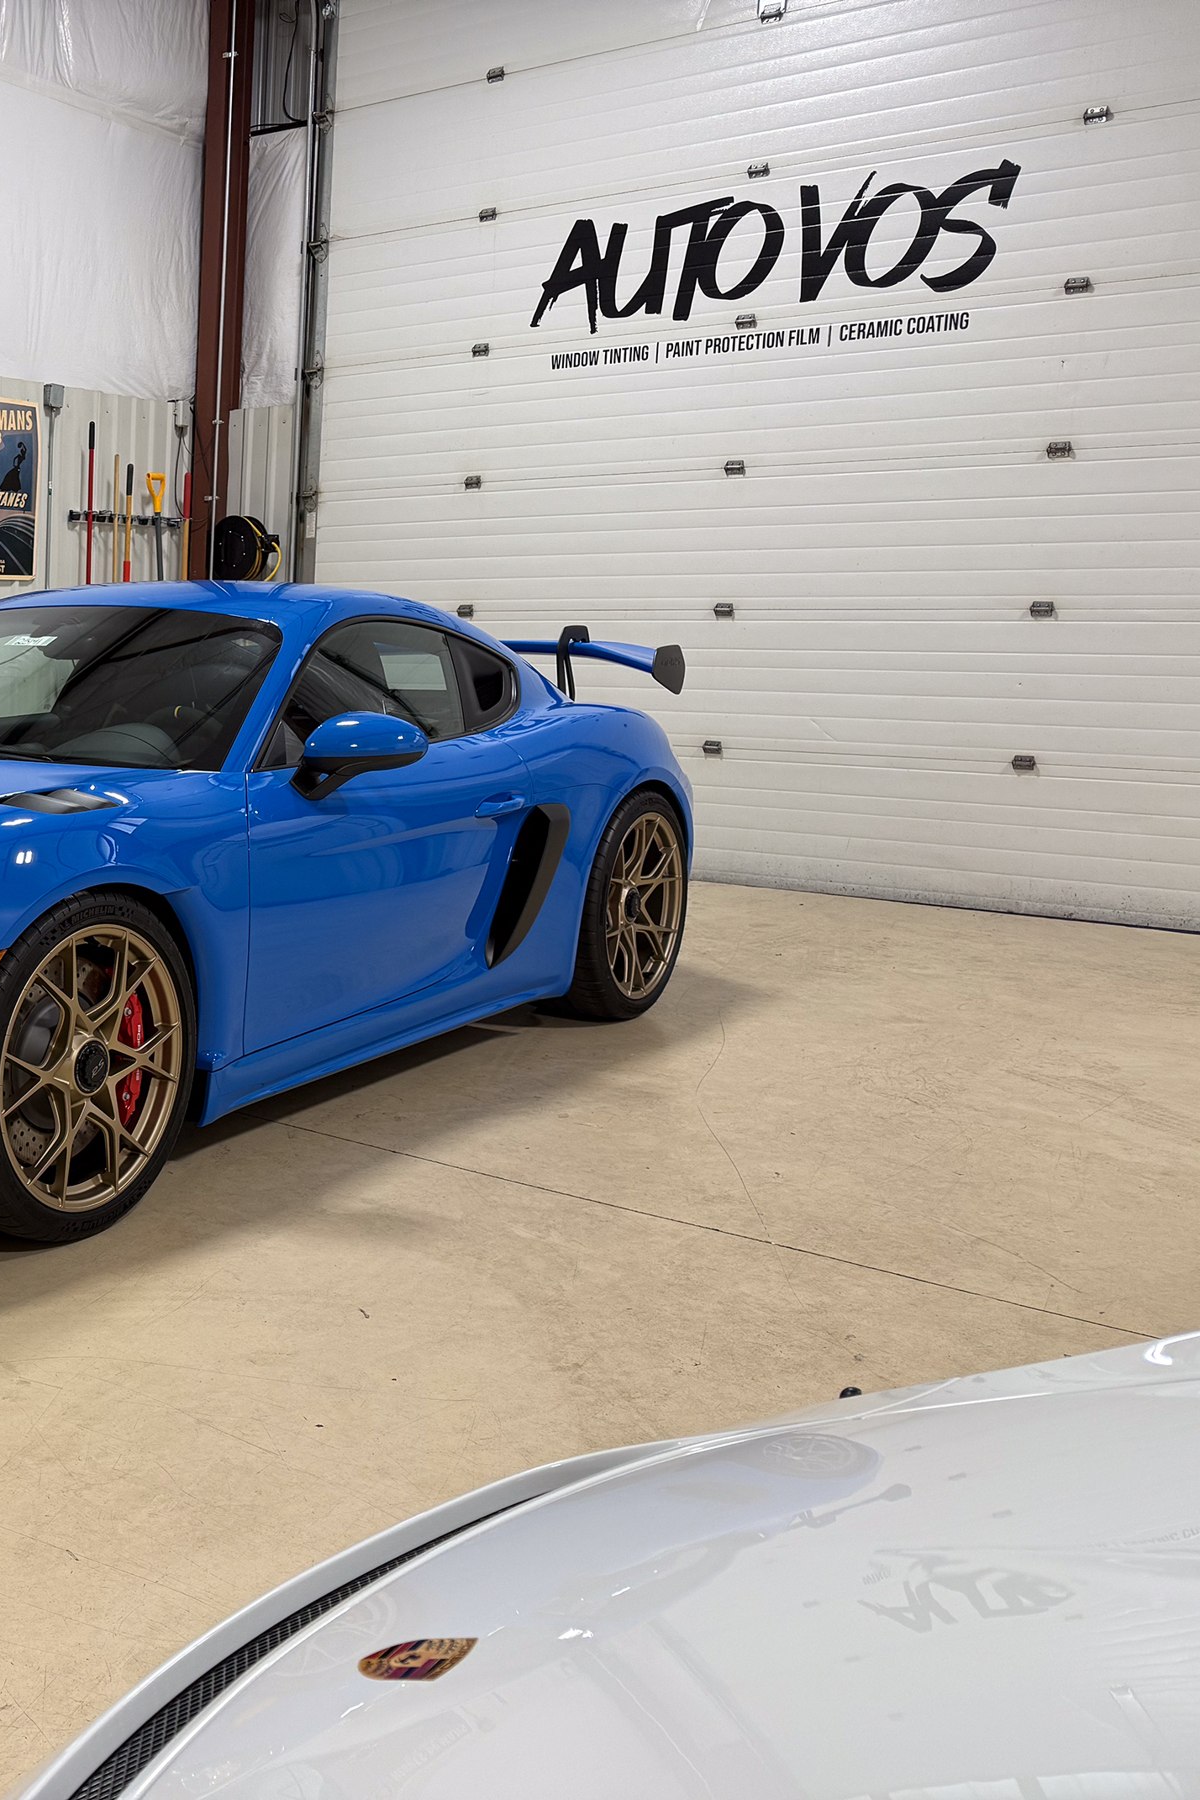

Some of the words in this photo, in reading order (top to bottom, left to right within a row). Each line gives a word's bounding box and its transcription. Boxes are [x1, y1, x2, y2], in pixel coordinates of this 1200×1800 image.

[530, 196, 784, 333] AUTO
[800, 158, 1021, 303] VOS
[550, 351, 600, 370] WINDOW
[603, 345, 649, 367] TINTING
[665, 339, 702, 359] PAINT
[705, 332, 784, 356] PROTECTION
[787, 327, 820, 348] FILM
[839, 318, 903, 342] CERAMIC
[907, 312, 970, 336] COATING
[71, 905, 115, 923] MICHELIN
